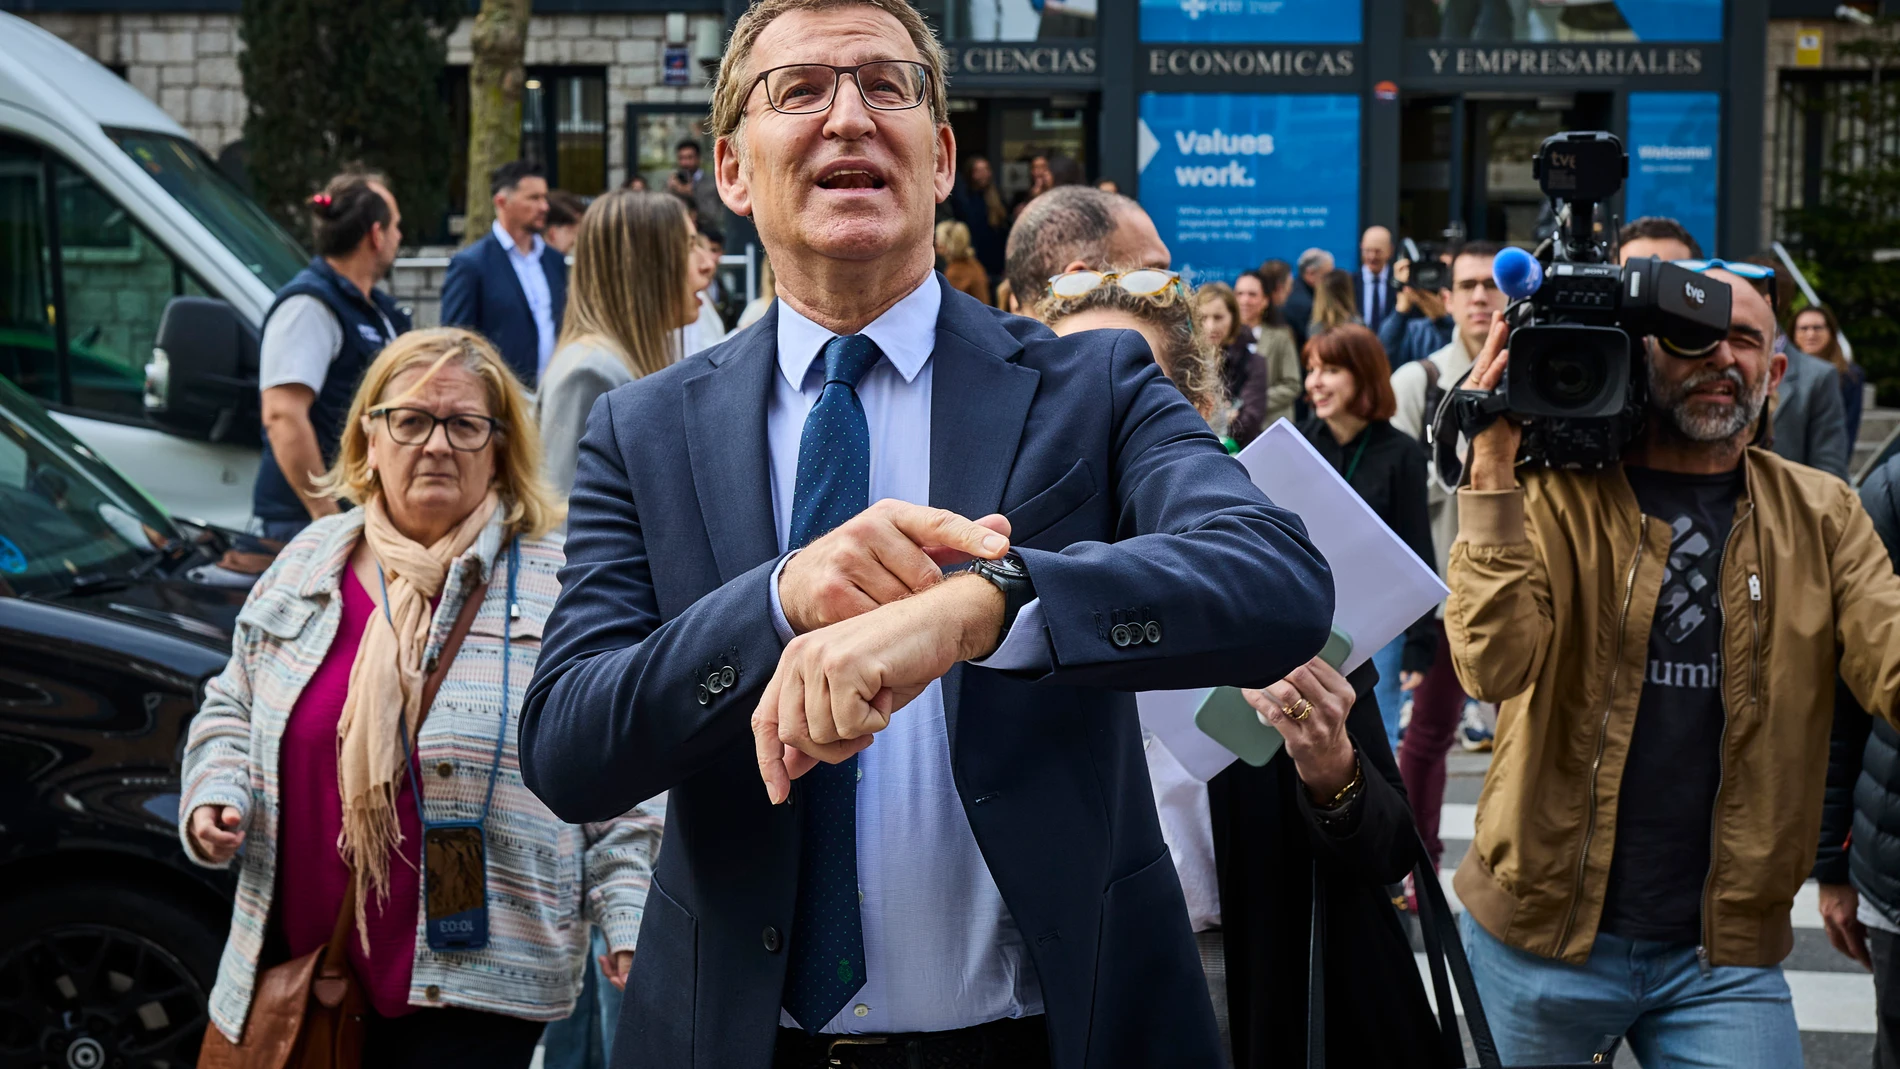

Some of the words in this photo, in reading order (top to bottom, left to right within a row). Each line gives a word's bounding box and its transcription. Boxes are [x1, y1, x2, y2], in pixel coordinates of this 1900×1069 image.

[963, 47, 1097, 74] CIENCIAS
[1149, 49, 1354, 76] ECONOMICAS
[1428, 49, 1449, 74] Y
[1456, 49, 1702, 75] EMPRESARIALES
[1175, 128, 1274, 155] Values
[1175, 160, 1255, 187] work.
[1685, 282, 1705, 304] tve
[1644, 652, 1720, 688] um
